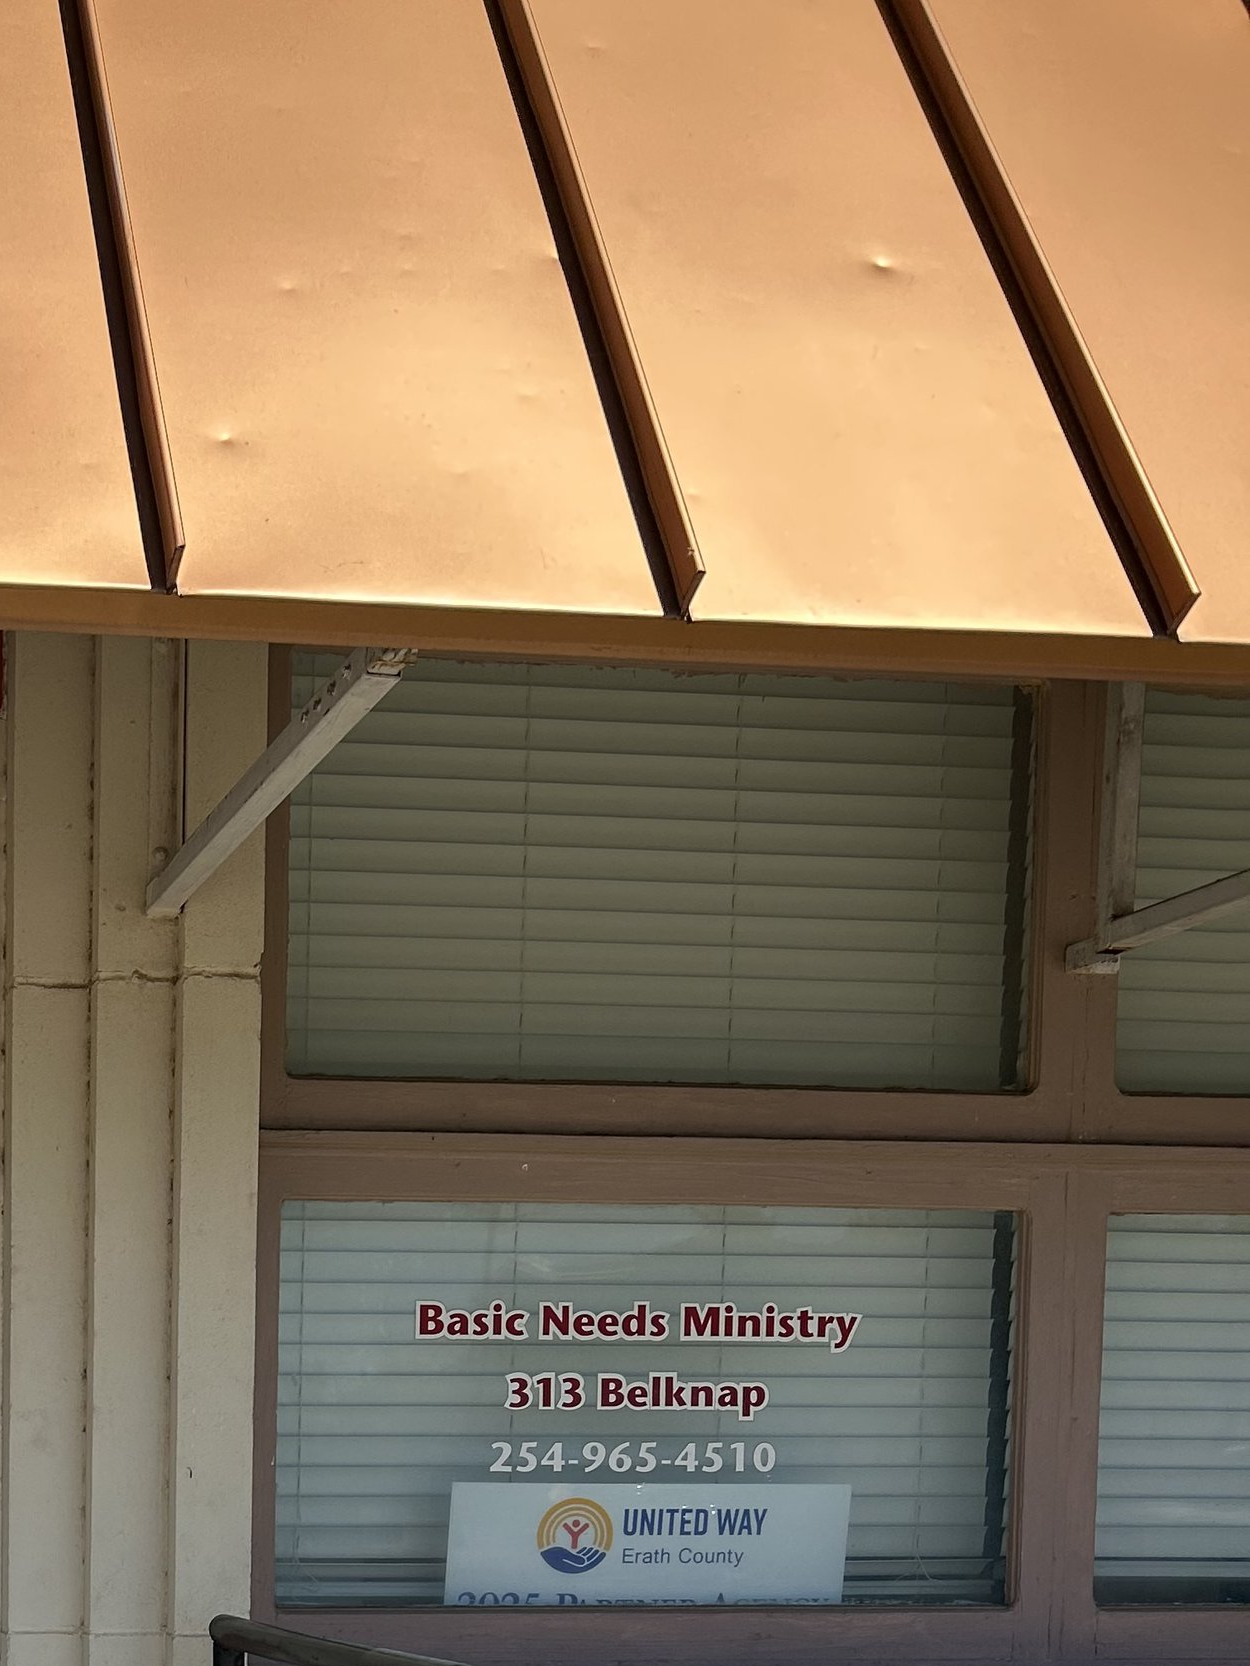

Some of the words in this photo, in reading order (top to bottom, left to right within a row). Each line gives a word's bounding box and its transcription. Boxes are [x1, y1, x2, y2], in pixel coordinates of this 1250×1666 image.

[416, 1300, 529, 1340] Basic
[539, 1301, 669, 1341] Needs
[681, 1302, 863, 1353] Ministry
[505, 1372, 585, 1411] 313
[597, 1372, 769, 1420] Belknap
[489, 1442, 776, 1473] 254-965-4510
[623, 1508, 708, 1536] UNITED
[717, 1508, 768, 1536] WAY
[622, 1548, 670, 1564] Erath
[678, 1548, 744, 1567] County
